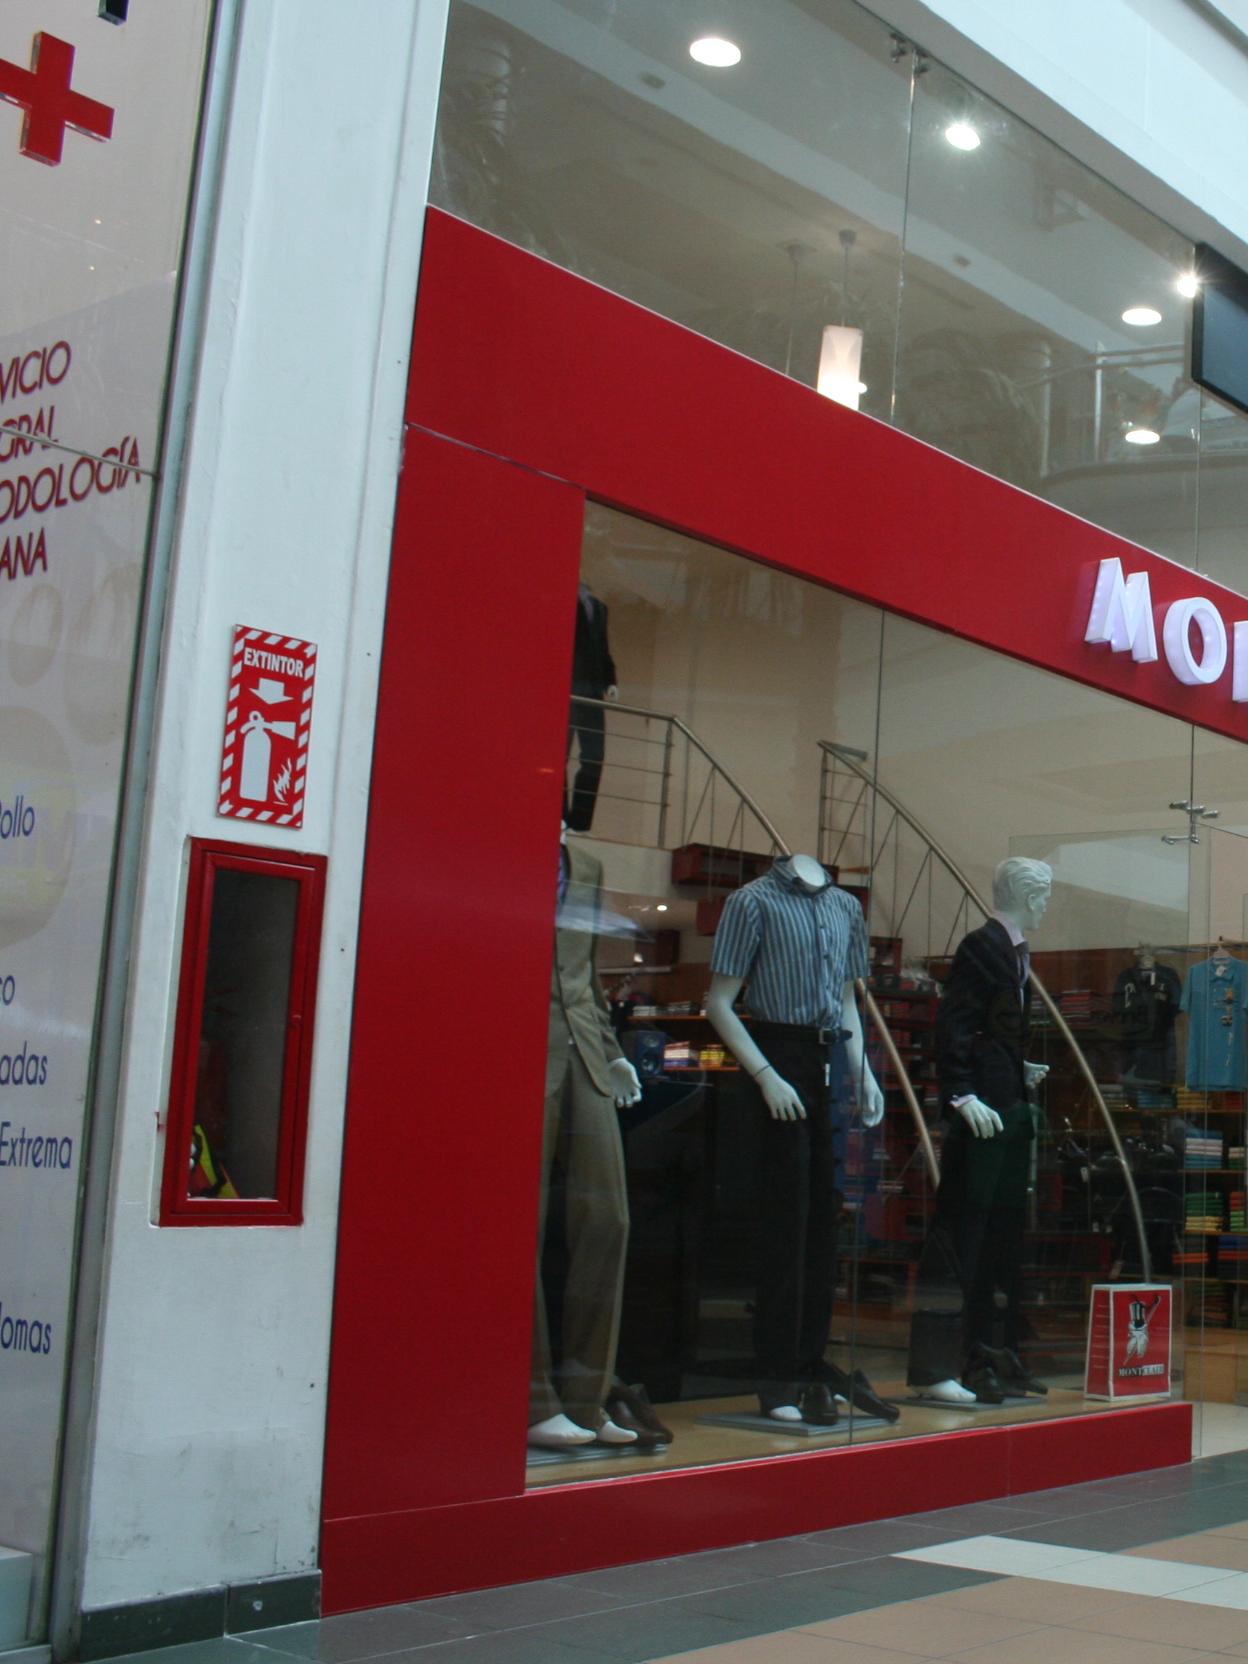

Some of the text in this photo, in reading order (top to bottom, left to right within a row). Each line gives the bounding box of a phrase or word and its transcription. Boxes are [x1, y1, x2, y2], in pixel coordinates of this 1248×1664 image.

[0, 340, 72, 405] VICIO
[0, 526, 48, 580] ANA
[244, 646, 304, 679] EXTINTOR
[0, 795, 35, 839] ollo
[0, 974, 15, 1006] o
[0, 1040, 48, 1085] adas
[0, 1121, 73, 1169] Extrema
[0, 1301, 51, 1355] omas
